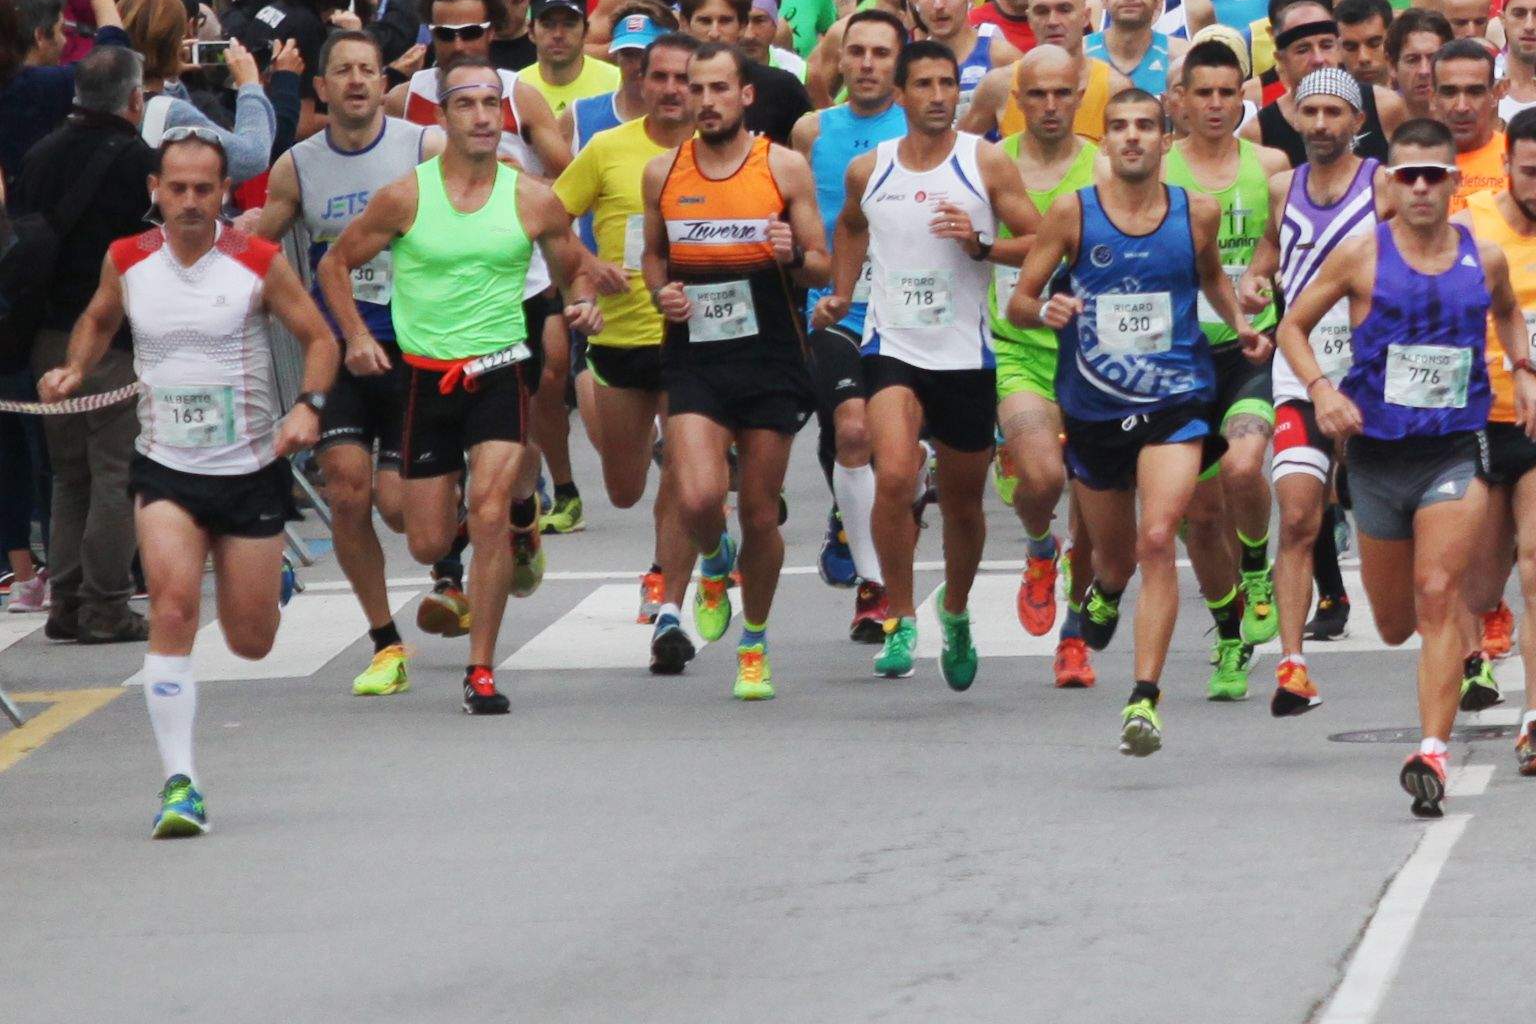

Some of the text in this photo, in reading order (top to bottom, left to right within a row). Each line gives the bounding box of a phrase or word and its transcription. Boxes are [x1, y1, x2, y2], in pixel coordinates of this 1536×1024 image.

[1458, 174, 1504, 188] tletisme
[321, 191, 369, 220] JETS
[678, 221, 756, 241] Inverse
[901, 277, 935, 286] PEDRO
[697, 289, 736, 302] HECTOR
[903, 290, 934, 306] 718
[704, 302, 733, 320] 489
[1114, 303, 1153, 313] RICARD
[1118, 316, 1150, 333] 630
[1321, 326, 1350, 336] PEDR
[1401, 354, 1450, 365] ALFONSO
[1408, 367, 1440, 385] 776
[163, 394, 211, 405] ALBERTO
[172, 408, 204, 424] 163
